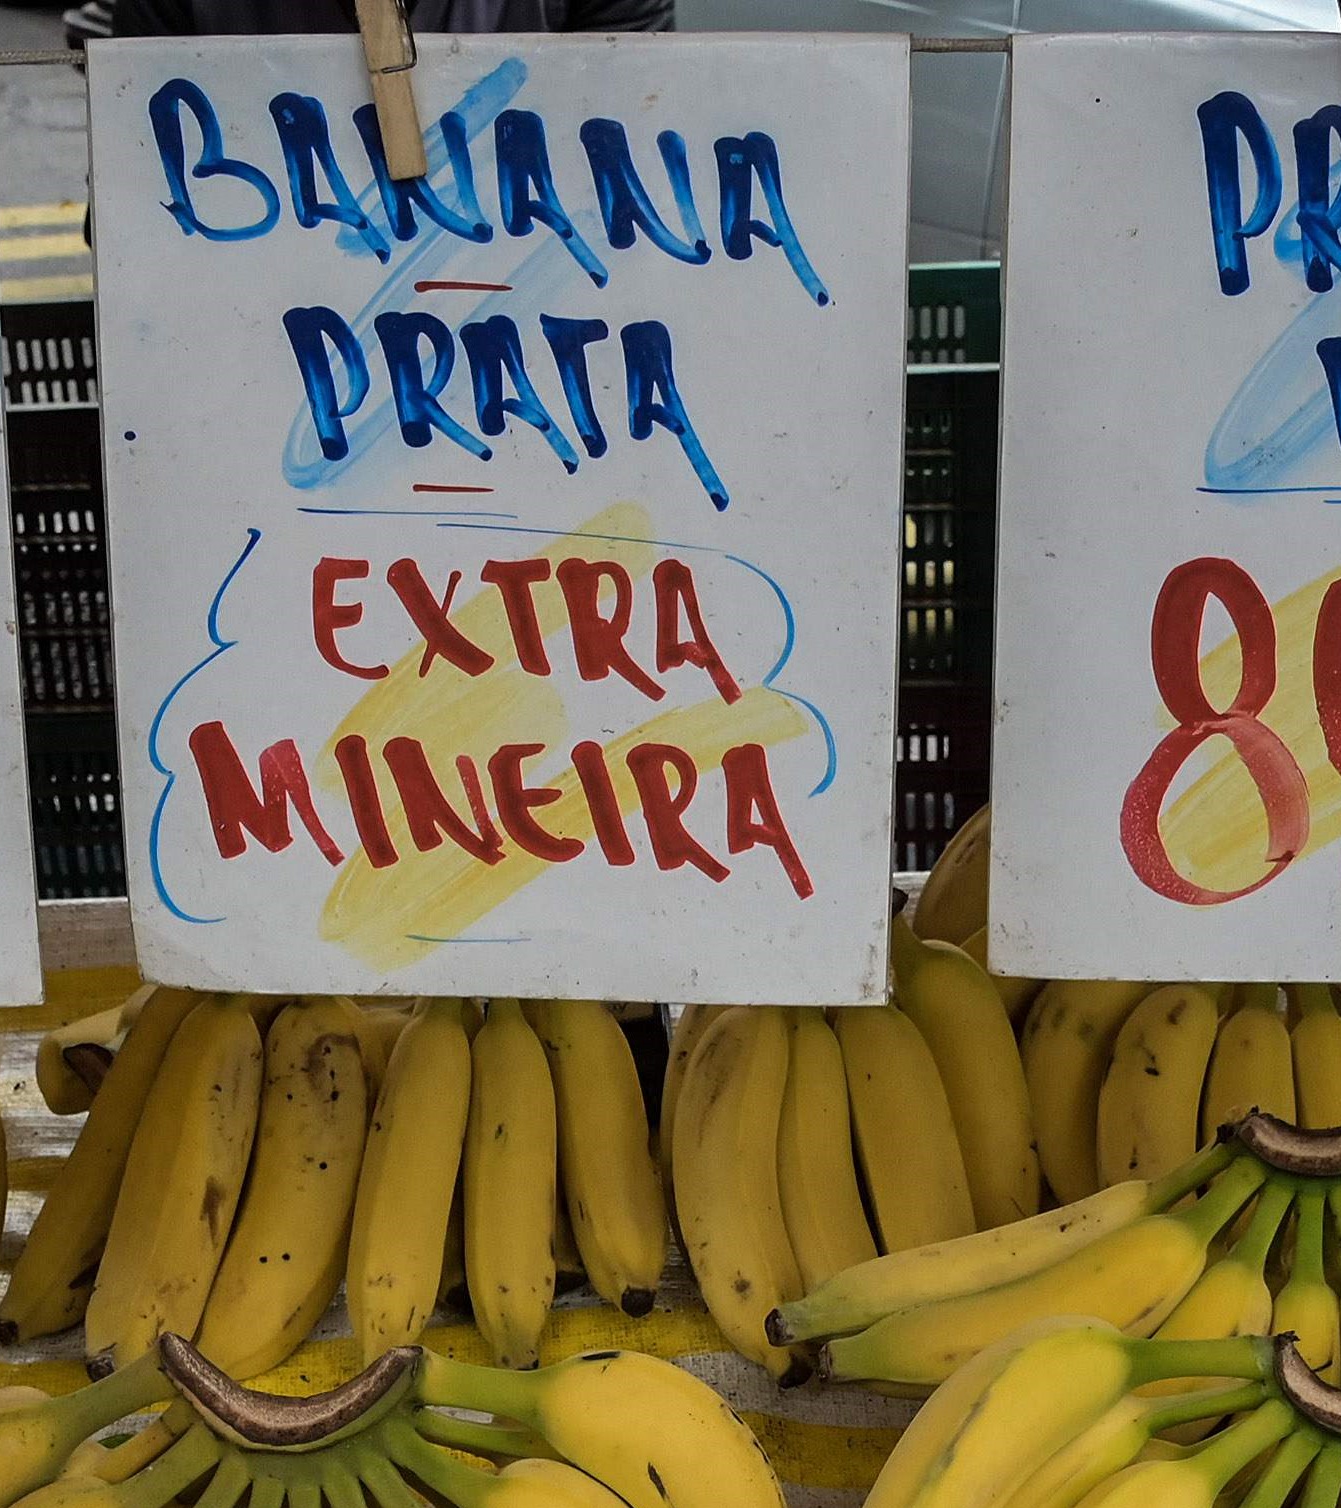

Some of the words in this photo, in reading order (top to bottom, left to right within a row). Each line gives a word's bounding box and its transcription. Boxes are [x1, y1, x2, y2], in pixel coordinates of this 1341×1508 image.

[148, 78, 829, 307] BANANA
[282, 307, 729, 512] PRATA
[311, 557, 742, 705] EXTRA
[189, 719, 814, 900] MINEIRA
